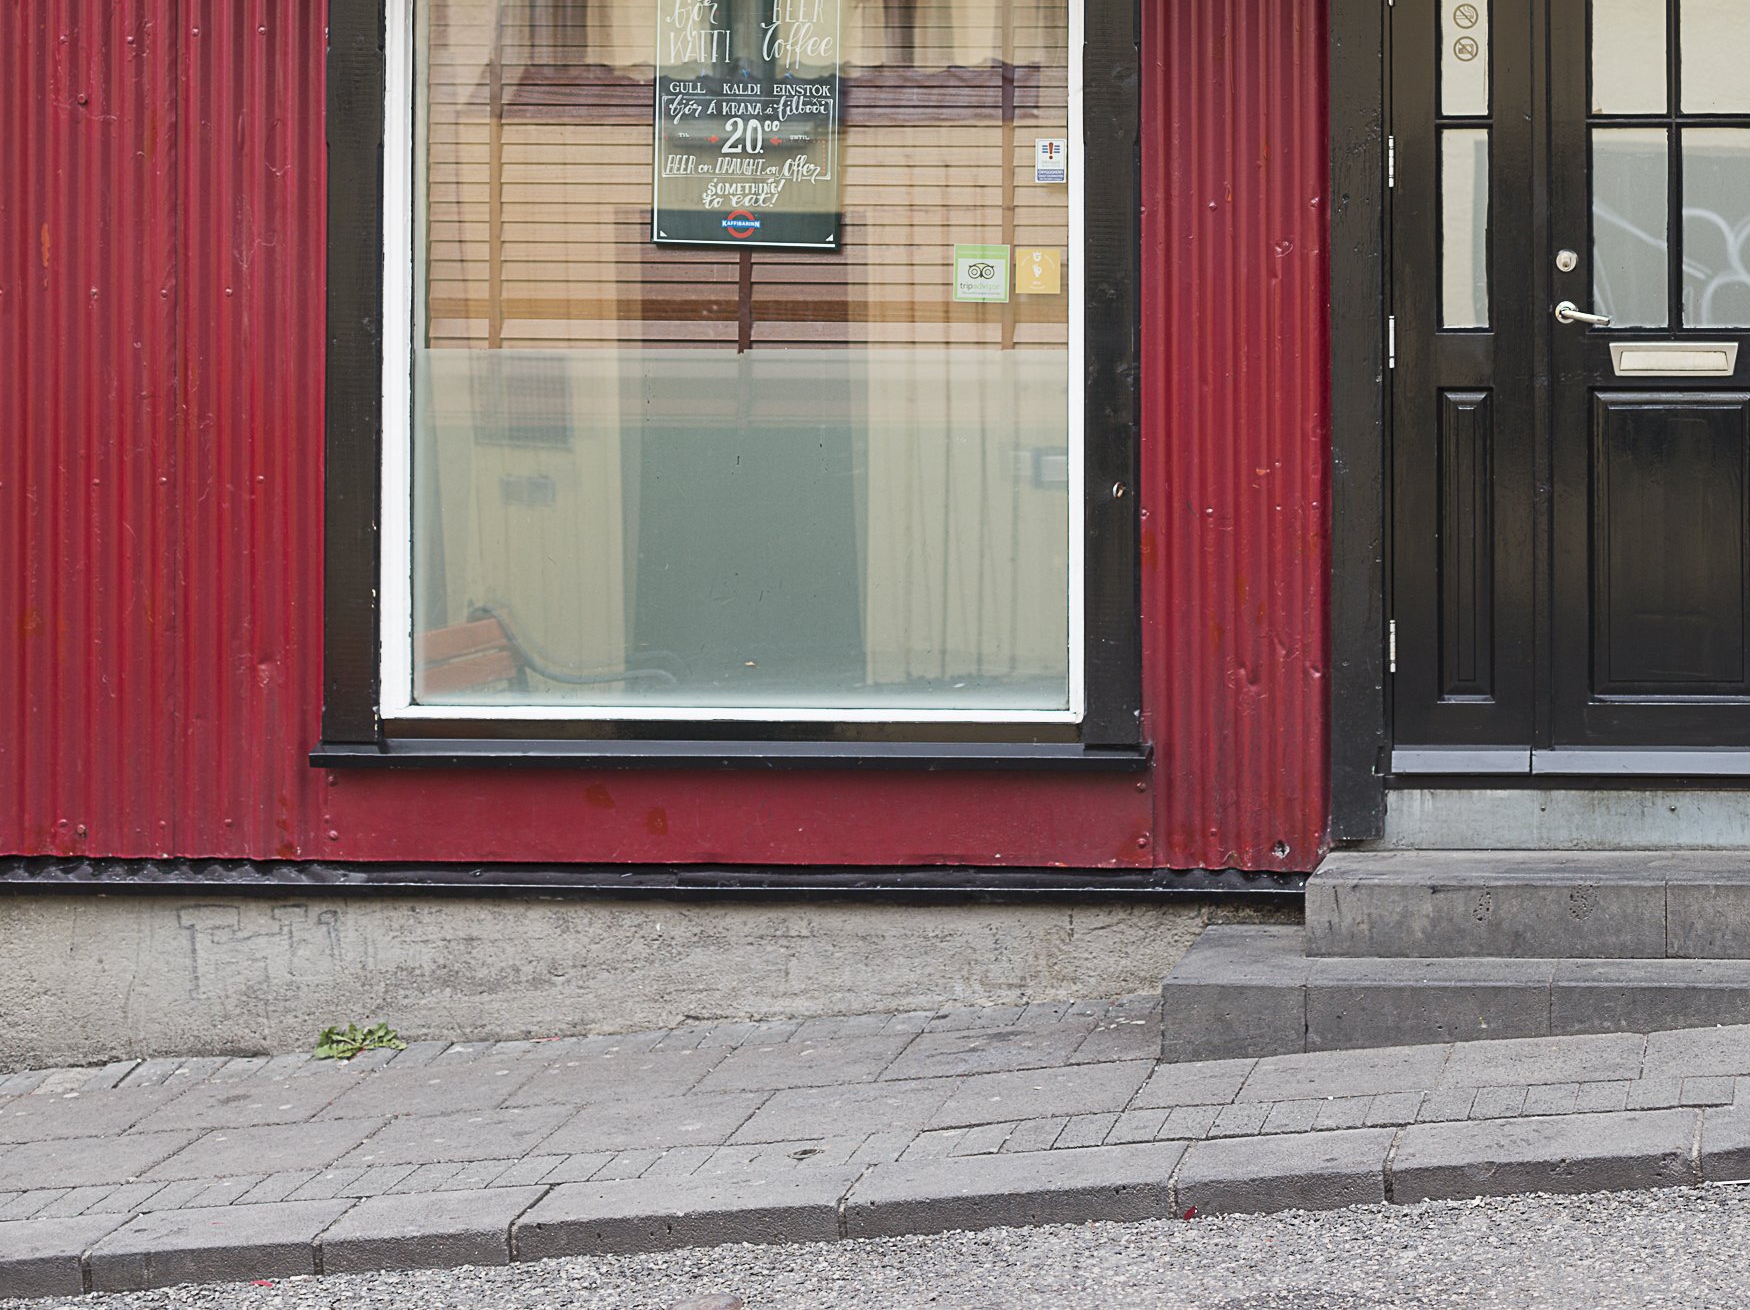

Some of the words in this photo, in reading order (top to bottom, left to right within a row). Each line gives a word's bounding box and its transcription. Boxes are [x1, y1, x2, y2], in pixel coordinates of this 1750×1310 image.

[760, 22, 833, 70] Coffee
[670, 81, 706, 94] GULL
[723, 83, 761, 95] KALDI
[722, 102, 763, 116] KRANA
[665, 154, 697, 175] BEER
[702, 192, 724, 209] to
